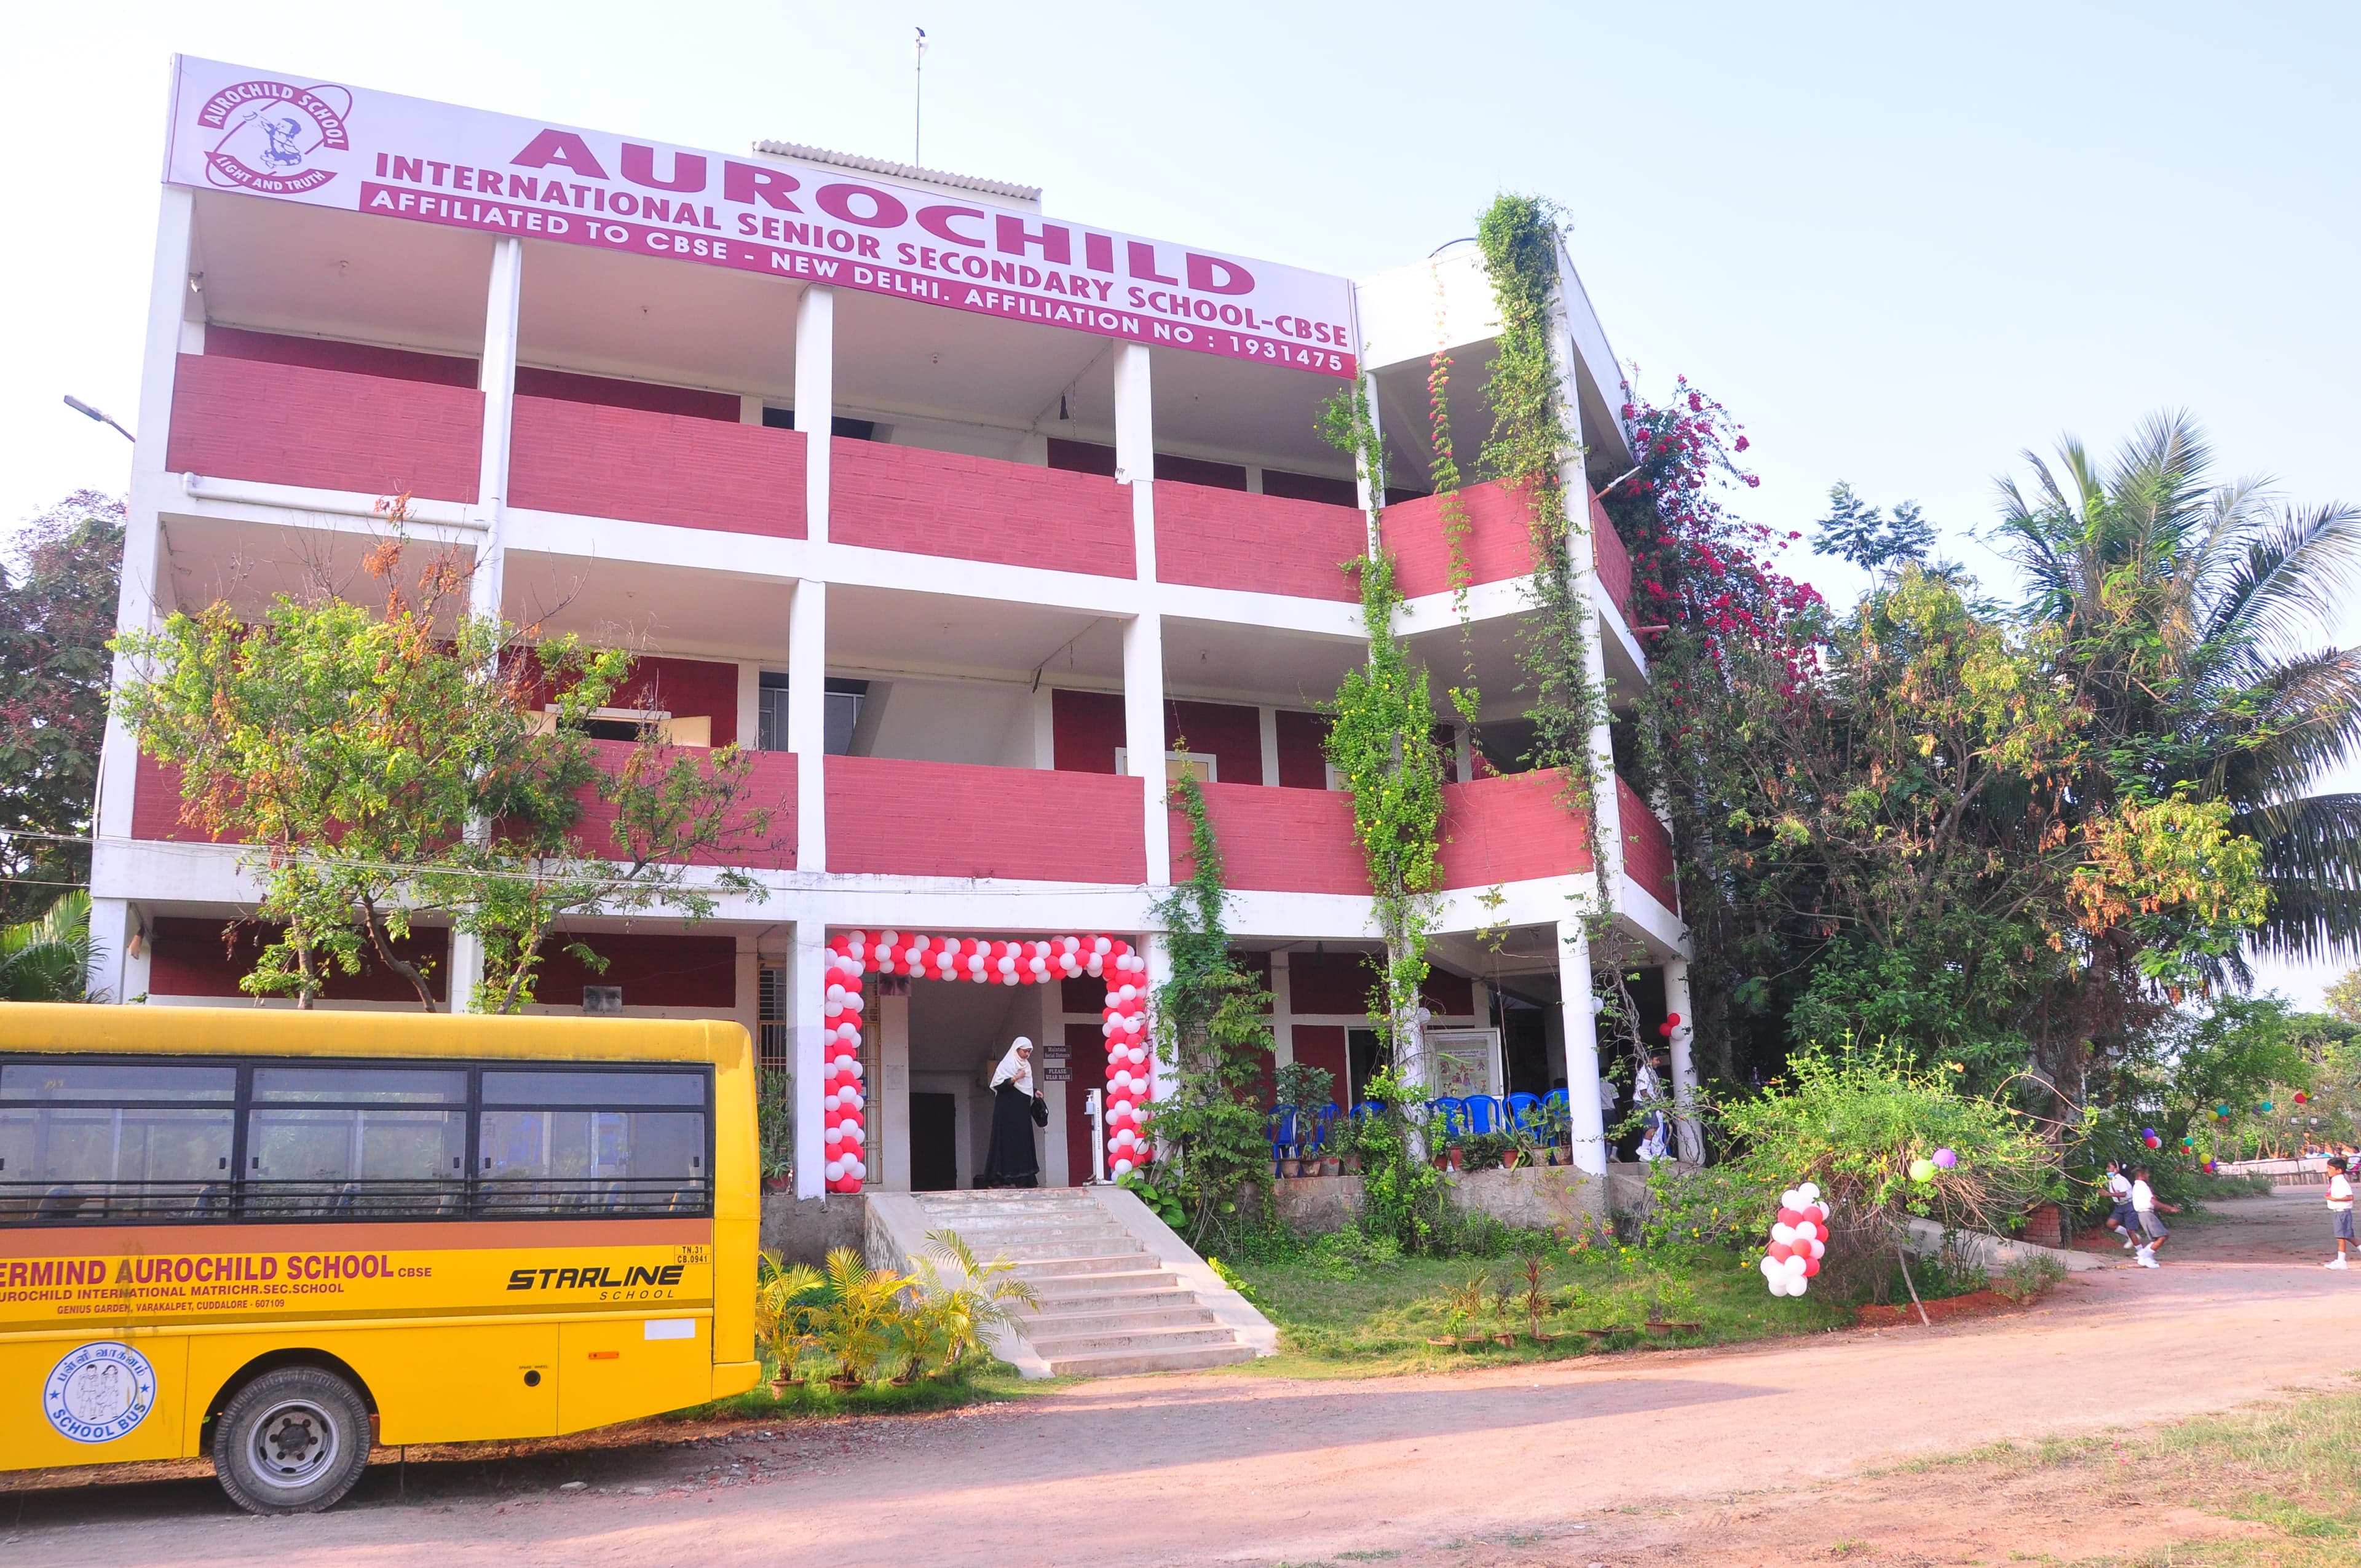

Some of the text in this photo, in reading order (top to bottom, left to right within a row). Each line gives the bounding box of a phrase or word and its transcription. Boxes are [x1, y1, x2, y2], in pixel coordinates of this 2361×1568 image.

[204, 84, 344, 145] AUROCHILD SCHOOL
[216, 156, 326, 191] LIGHT AND TRUTH
[509, 128, 1256, 295] AUROCHILD
[375, 152, 1348, 347] INTERNATIONAL SENIOR SECONDARY SCHOOL-CBSE
[370, 189, 569, 234] AFFILIATED
[586, 221, 629, 244] TO
[646, 232, 727, 260] CBSE
[771, 251, 839, 278] NEW
[854, 266, 950, 301] DELHI.
[965, 288, 1140, 335] AFFILIATION
[1153, 322, 1193, 344] NO
[1230, 336, 1343, 371] 1931475
[115, 1257, 277, 1284] AUROCHILD
[287, 1254, 394, 1280] SCHOOL
[398, 1267, 432, 1277] CBSE
[506, 1265, 685, 1291] STARLINE
[57, 1305, 91, 1314] GENIUS
[94, 1304, 133, 1313] GARDEN,
[136, 1302, 194, 1312] VARAKALPET,
[197, 1299, 248, 1310] CUDDALORE
[255, 1299, 285, 1309] 607109
[77, 1286, 186, 1299] INTERNATIONAL
[191, 1283, 344, 1296] MATRICHR.SEC.SCHOOL
[599, 1289, 674, 1301] SCHOOL
[53, 1403, 146, 1438] SCHOOL BUS
